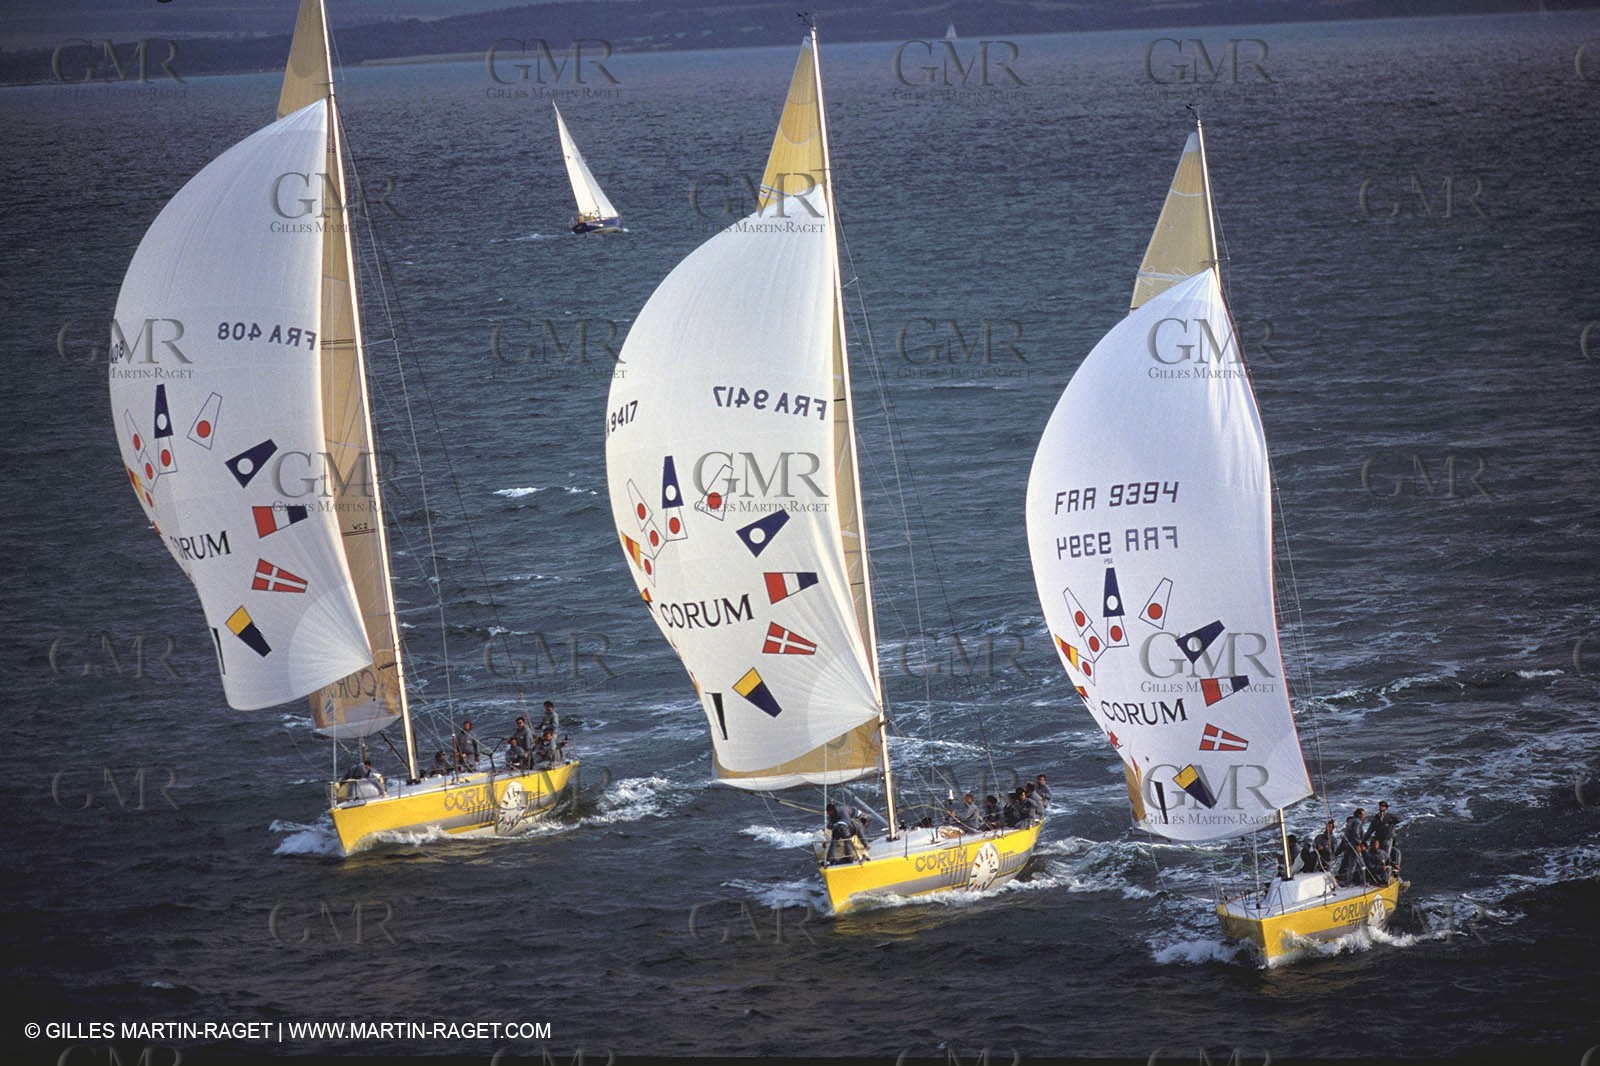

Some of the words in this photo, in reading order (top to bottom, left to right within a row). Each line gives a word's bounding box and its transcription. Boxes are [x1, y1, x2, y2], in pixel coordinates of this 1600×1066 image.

[611, 399, 639, 433] 9417
[1055, 487, 1097, 515] FRA
[1109, 481, 1180, 507] 9394
[660, 593, 755, 629] CORUM
[1101, 698, 1188, 725] CORUM
[915, 846, 969, 872] CORUM
